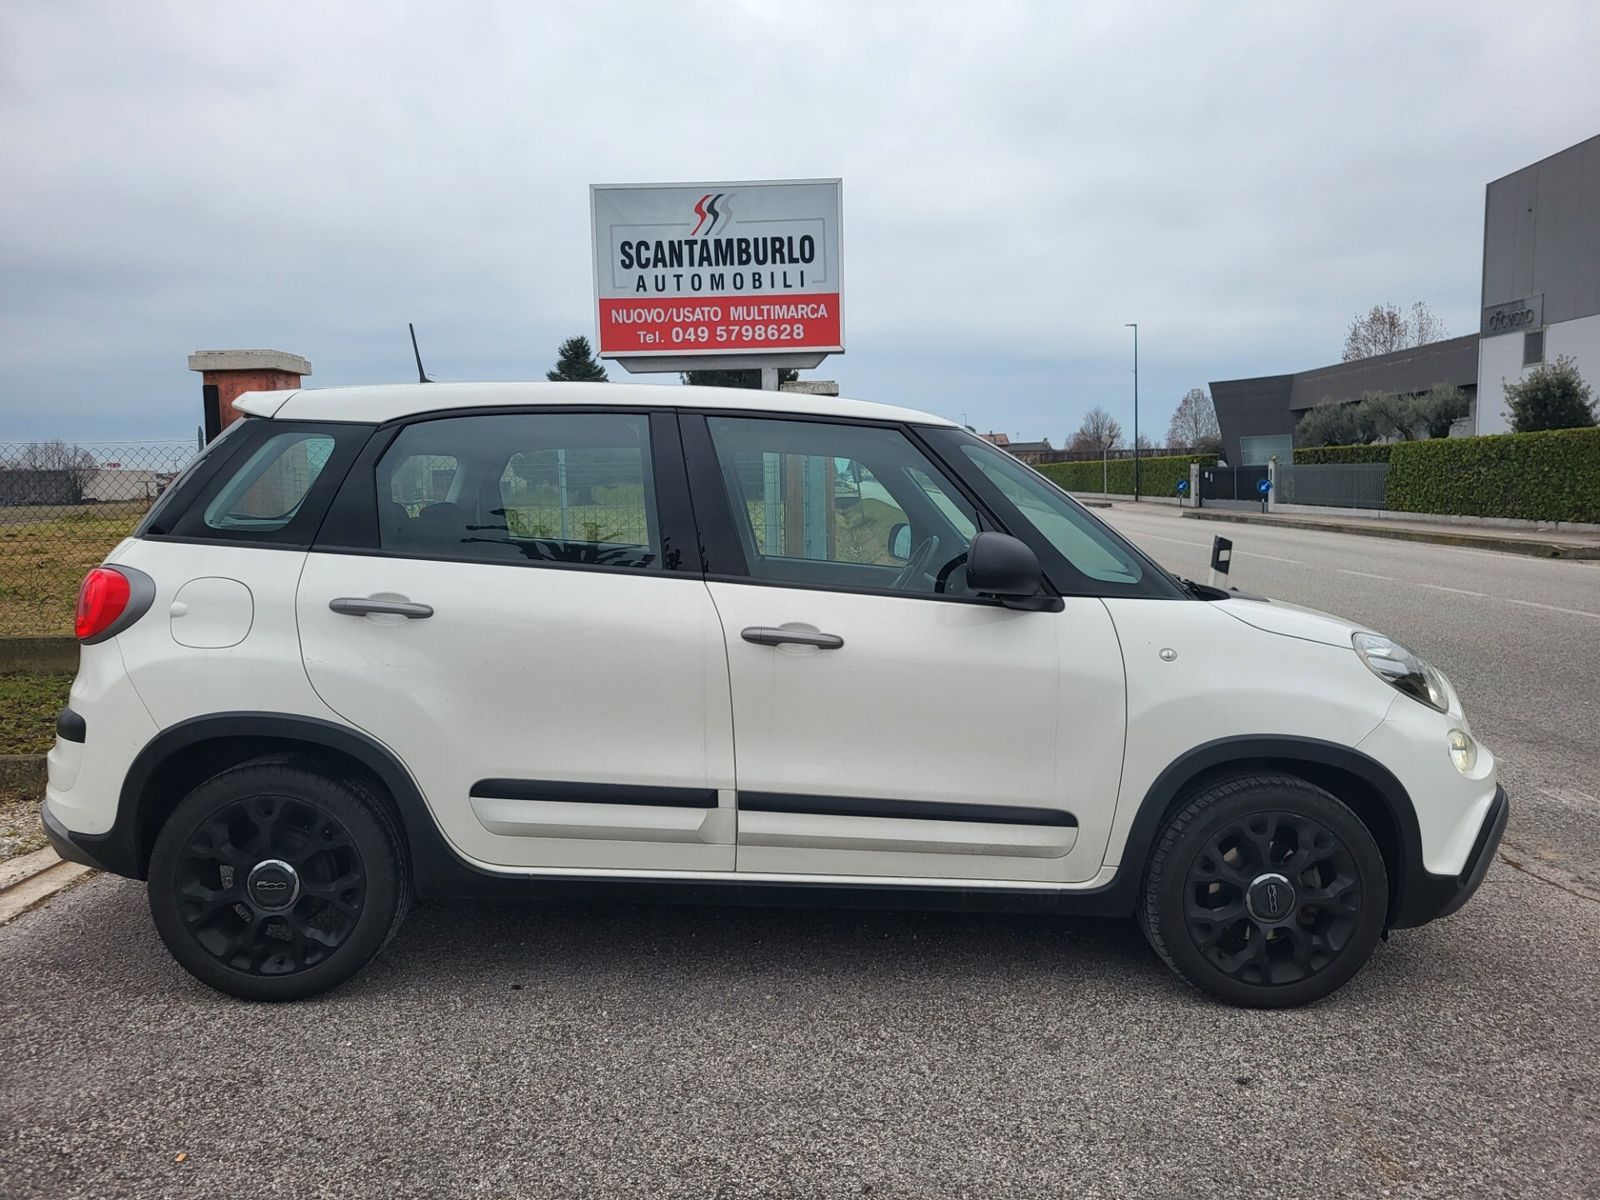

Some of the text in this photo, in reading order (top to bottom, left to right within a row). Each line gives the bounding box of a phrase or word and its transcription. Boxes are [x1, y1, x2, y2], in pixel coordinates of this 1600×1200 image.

[620, 234, 816, 270] SCANTAMBURLO
[635, 270, 805, 293] AUTOMOBILI
[611, 303, 828, 324] NUOVO/USATO MULTIMARCA
[637, 323, 805, 344] Tel. 049 5798628
